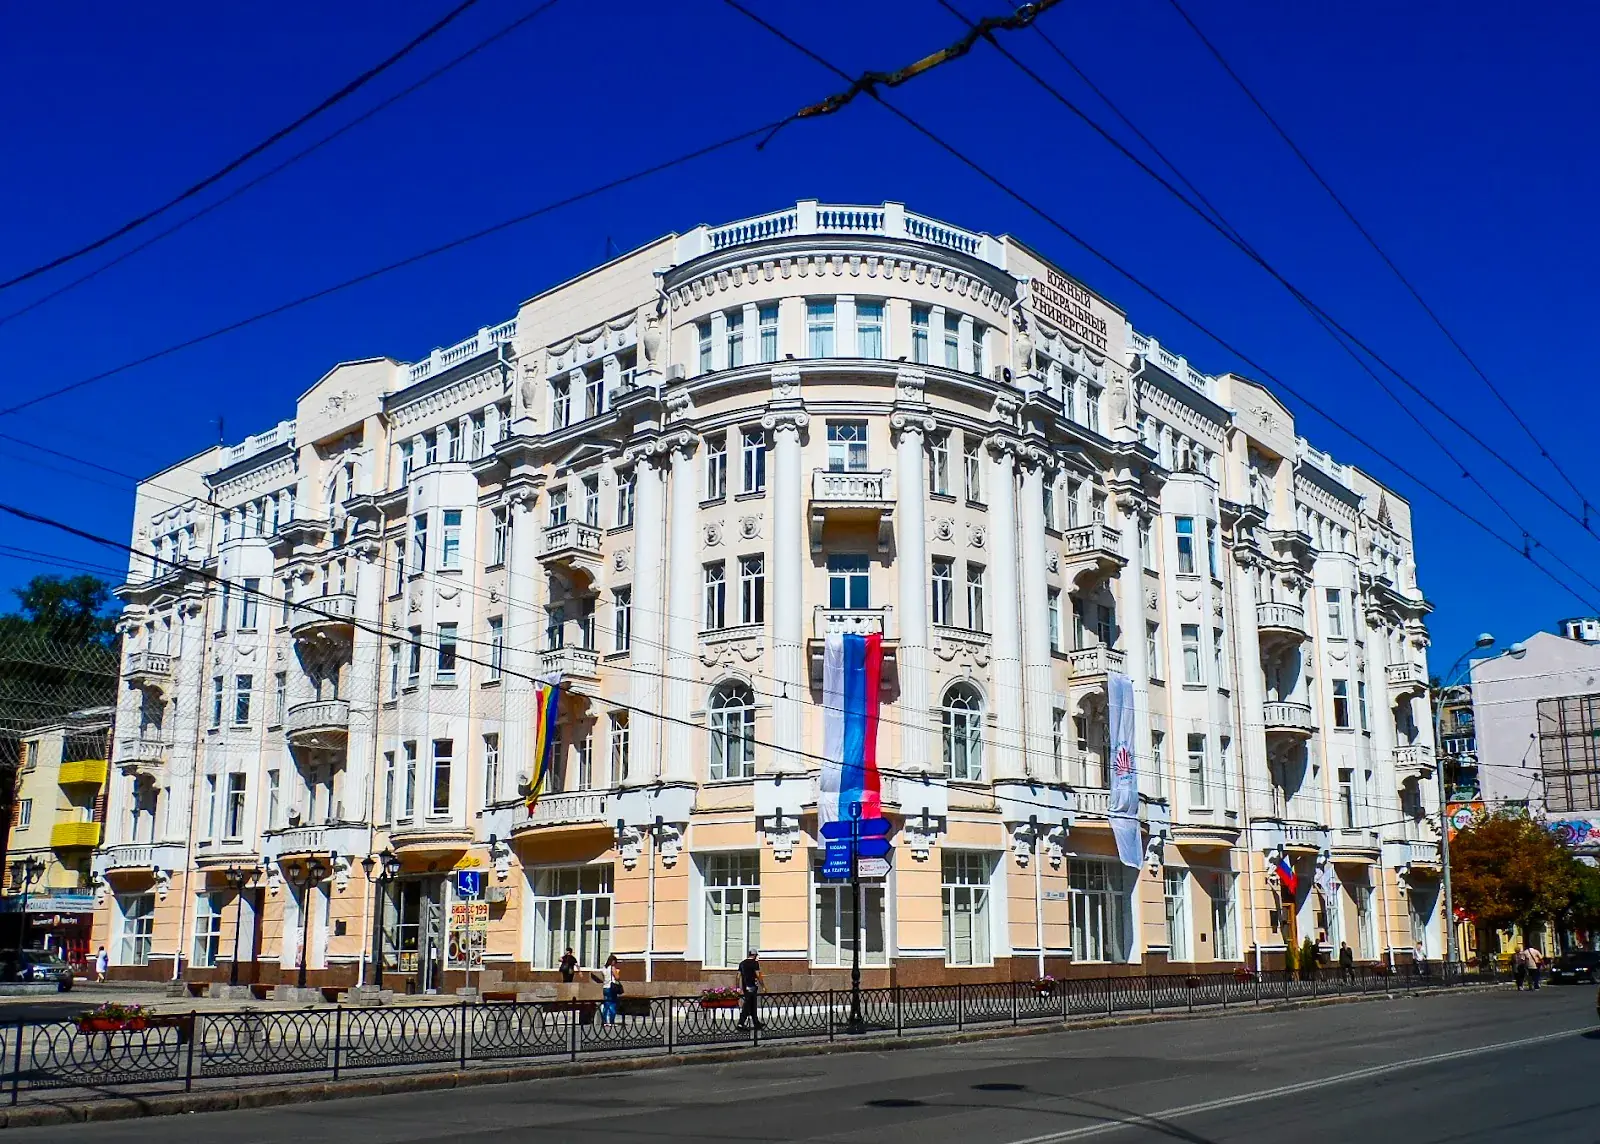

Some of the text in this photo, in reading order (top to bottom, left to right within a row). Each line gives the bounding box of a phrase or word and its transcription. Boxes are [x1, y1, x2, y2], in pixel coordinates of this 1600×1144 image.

[1031, 278, 1107, 336] ФЕДЕРАЛЬНЫЙ
[1047, 269, 1091, 309] ЮЖНЫЙ
[1032, 294, 1108, 352] УНИВЕРСИТЕТ
[476, 904, 488, 915] 199
